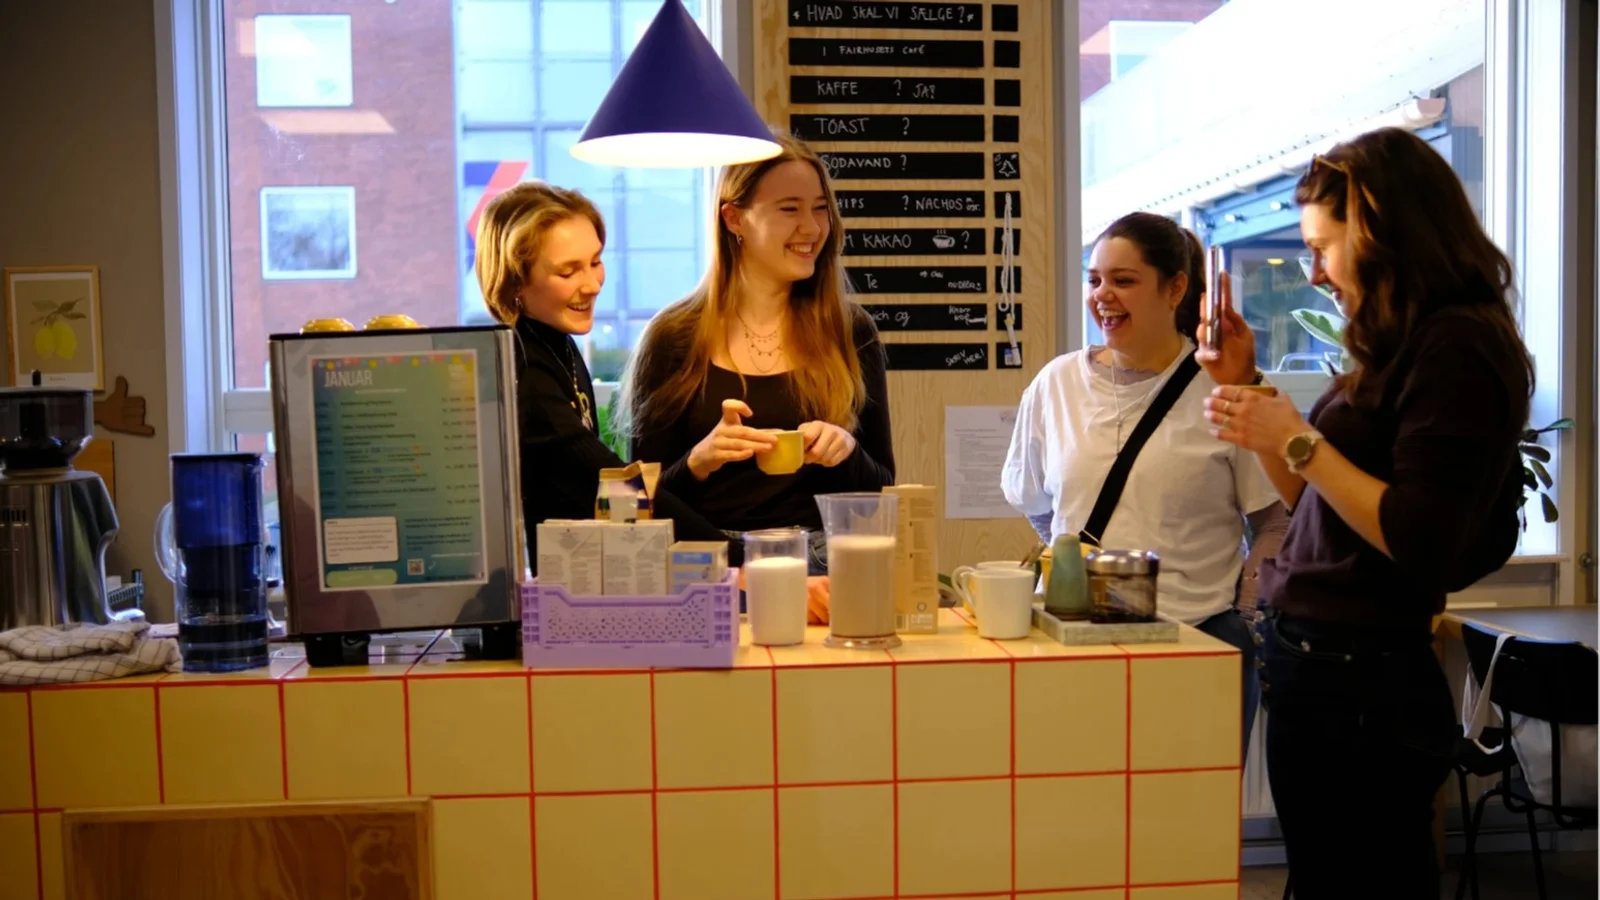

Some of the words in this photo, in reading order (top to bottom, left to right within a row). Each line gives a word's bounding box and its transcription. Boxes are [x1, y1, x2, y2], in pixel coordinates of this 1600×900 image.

[806, 4, 843, 21] HVAD
[852, 6, 883, 19] SKAL
[885, 6, 899, 19] VI
[817, 80, 859, 95] KAFFE
[894, 79, 902, 96] ?
[813, 117, 870, 134] TOAST
[902, 117, 910, 135] ?
[900, 154, 907, 171] ?
[836, 197, 865, 209] HIPS
[901, 195, 909, 211] ?
[915, 197, 963, 211] NACHOS
[862, 233, 912, 249] KAKAO
[961, 230, 970, 250] ?
[324, 369, 373, 388] JANUAR
